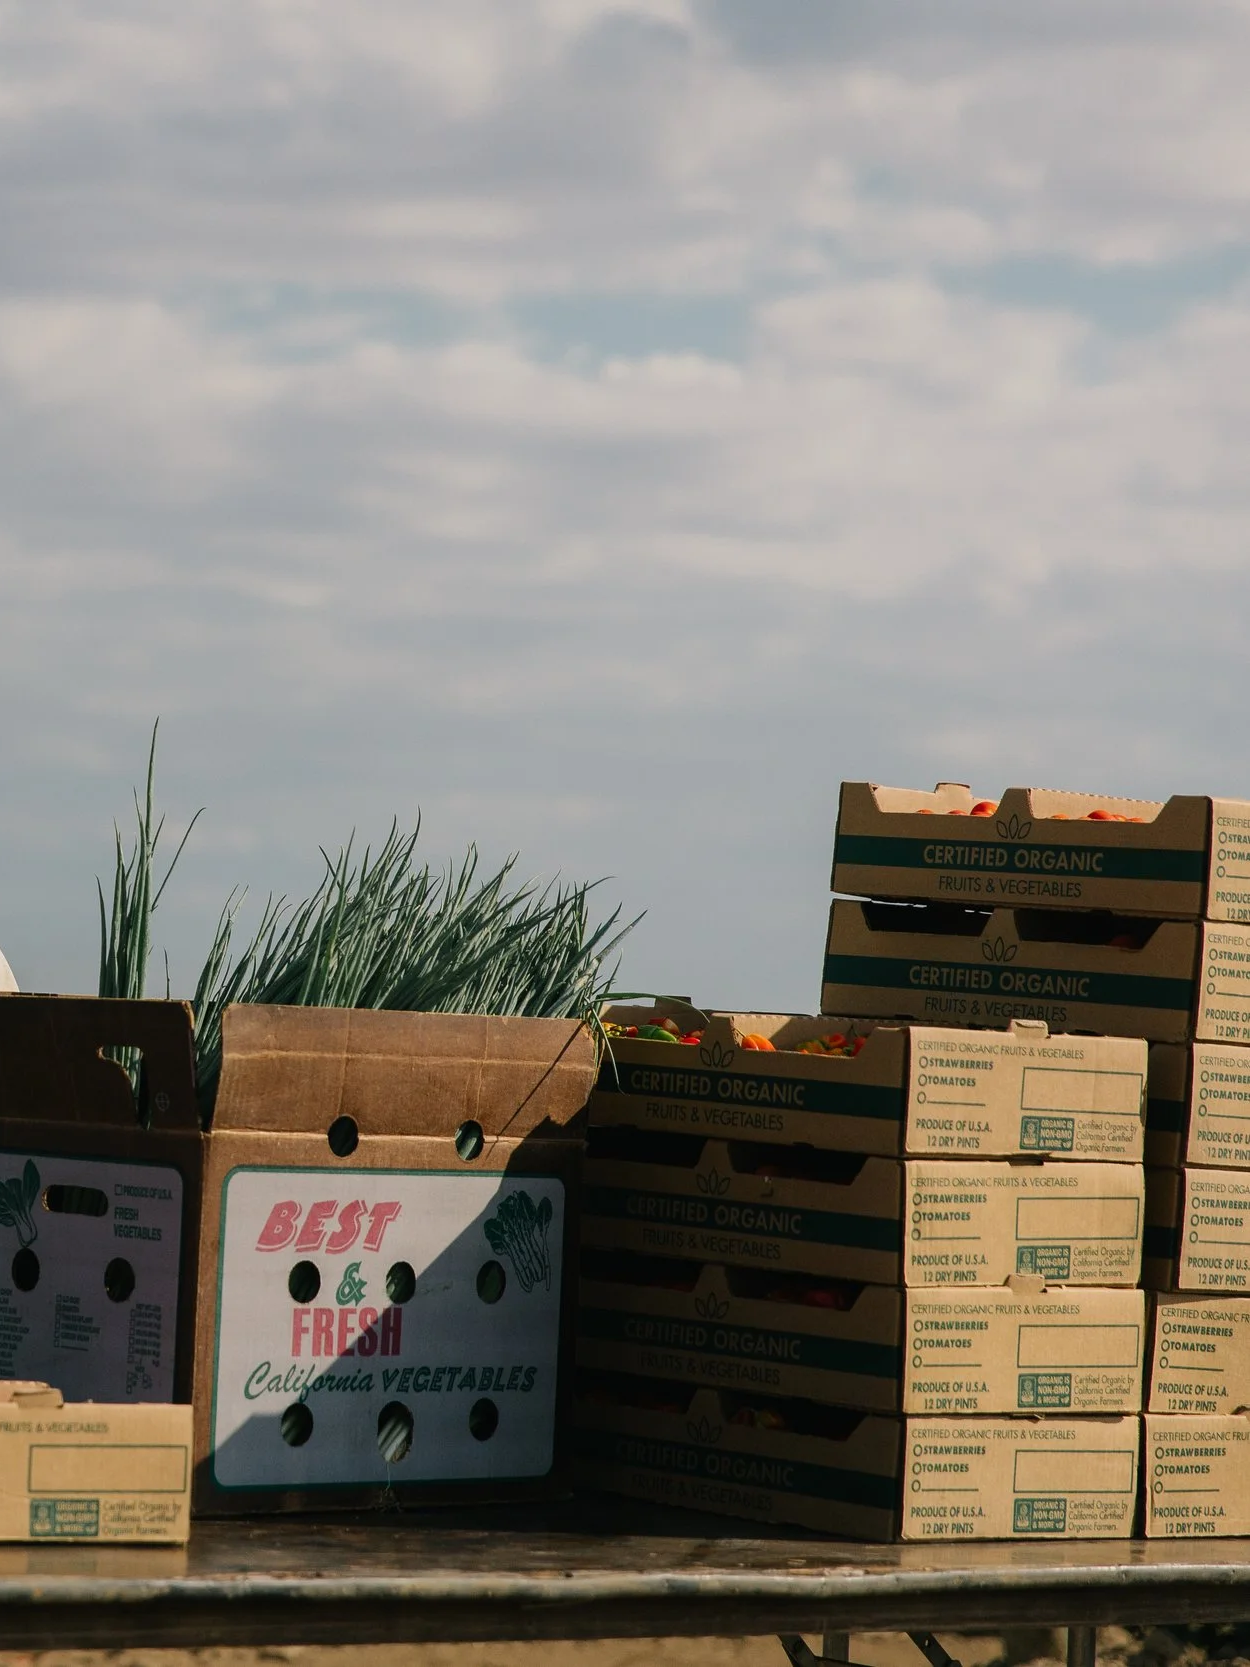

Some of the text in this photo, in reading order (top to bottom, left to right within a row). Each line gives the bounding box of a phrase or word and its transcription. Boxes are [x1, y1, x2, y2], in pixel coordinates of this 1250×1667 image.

[923, 844, 1104, 872] CERTIFIED ORGANIC
[938, 875, 1082, 898] FRUITS & VEGETABLES
[1208, 934, 1243, 944] CERTIFIED
[909, 965, 1090, 997] CERTIFIED ORGANIC
[924, 996, 1067, 1022] FRUITS & VEGETABLES
[1206, 1009, 1239, 1020] PRODUCE
[1215, 1025, 1240, 1036] 12 DRY
[917, 1040, 1083, 1058] CERTIFIED ORGANIC FRUITS & VEGETABLES
[930, 1057, 993, 1069] STRAWBERRIES
[1198, 1056, 1235, 1066] CERTIFIED
[928, 1076, 976, 1086] TOMATOES
[630, 1070, 805, 1106] CERTIFIED ORGANIC
[646, 1102, 783, 1131] FRUITS & VEGETABLES
[915, 1119, 992, 1131] PRODUCE OF U.S.A.
[1078, 1120, 1136, 1132] Certified Organic by
[927, 1135, 980, 1148] 12 DRY PINTS
[1108, 1133, 1132, 1141] Certified
[1197, 1131, 1244, 1142] PRODUCE OF
[1207, 1146, 1233, 1157] 12 DRY
[910, 1177, 1078, 1187] CERTIFIED ORGANIC FRUITS & VEGETABLES
[1190, 1182, 1226, 1191] CERTIFIED
[923, 1193, 986, 1203] STRAWBERRIES
[114, 1206, 139, 1221] FRESH
[625, 1195, 802, 1235] CERTIFIED ORGANIC
[922, 1212, 970, 1221] TOMATOES
[255, 1199, 402, 1255] BEST
[1199, 1217, 1243, 1226] TOMATOES
[113, 1223, 163, 1241] VEGETABLES
[642, 1228, 781, 1260] FRUITS & VEGETABLES
[912, 1255, 988, 1264] PRODUCE OF U.S.A.
[1188, 1258, 1234, 1268] PRODUCE OF
[924, 1270, 976, 1281] 12 DRY PINTS
[1198, 1273, 1246, 1285] 12 DRY PINTS
[335, 1261, 368, 1307] &
[912, 1304, 1079, 1314] CERTIFIED ORGANIC FRUITS & VEGETABLES
[1161, 1308, 1238, 1320] CERTIFIED ORGANIC
[925, 1320, 988, 1330] STRAWBERRIES
[1172, 1324, 1232, 1335] STRAWBERRIES
[291, 1307, 403, 1358] FRESH
[624, 1319, 802, 1360] CERTIFIED ORGANIC
[923, 1339, 971, 1348] TOMATOES
[1170, 1343, 1215, 1352] TOMATOES
[243, 1361, 538, 1404] California VEGETABLES
[913, 1383, 989, 1392] PRODUCE OF U.S.A.
[1157, 1383, 1193, 1393] PRODUCE
[1207, 1387, 1229, 1395] U.S.A.
[925, 1398, 977, 1409] 12 DRY PINTS
[1168, 1398, 1217, 1411] 12 DRY PINTS
[911, 1428, 1075, 1439] CERTIFIED ORGANIC FRUITS & VEGETABLES
[1151, 1431, 1230, 1440] CERTIFIED ORGANIC
[923, 1445, 986, 1454] STRAWBERRIES
[1164, 1446, 1225, 1456] STRAWBERRIES
[922, 1464, 969, 1472] TOMATOES
[1163, 1465, 1209, 1474] TOMATOES
[911, 1507, 985, 1517] PRODUCE OF U.S.A.
[1153, 1507, 1227, 1517] PRODUCE OF U.S.A.
[922, 1523, 974, 1533] 12 DRY PINTS
[1165, 1522, 1216, 1532] 12 DRY PINTS
